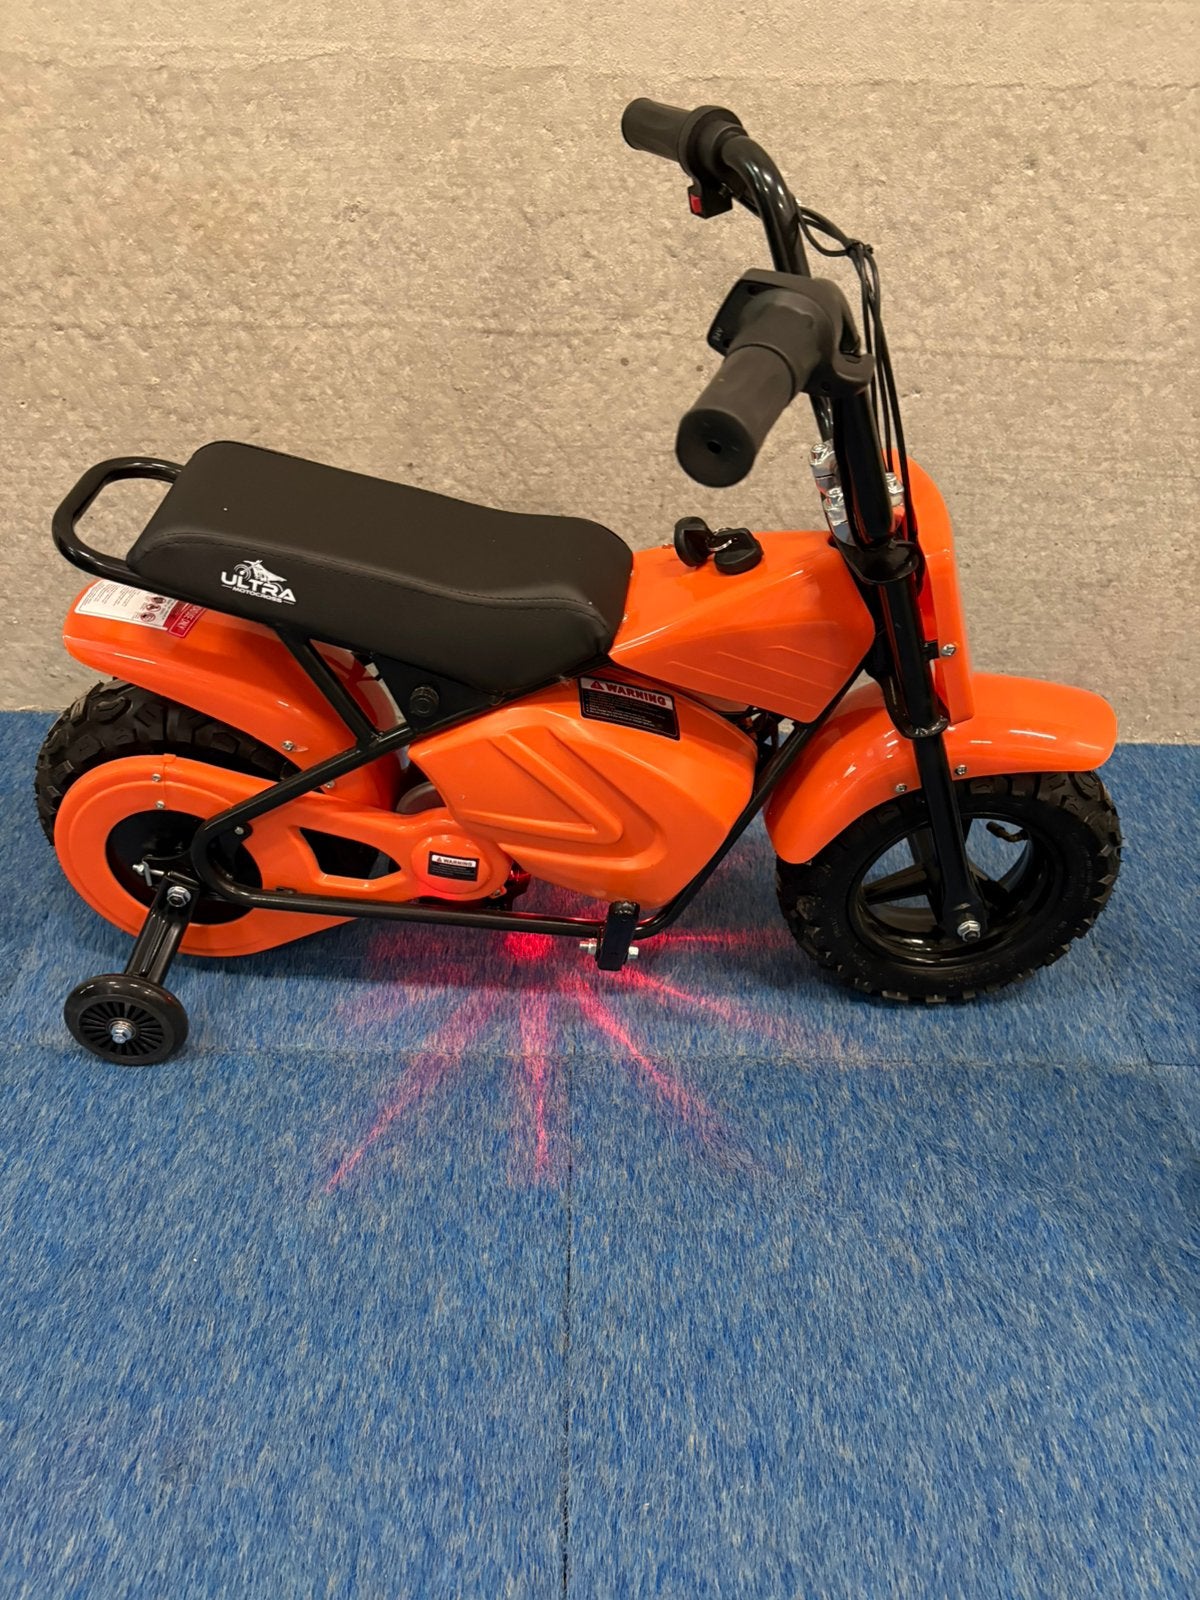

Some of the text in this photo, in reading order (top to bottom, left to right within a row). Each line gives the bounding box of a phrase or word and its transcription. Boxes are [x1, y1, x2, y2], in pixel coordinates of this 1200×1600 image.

[221, 571, 296, 602] ULTRA
[232, 586, 282, 603] MOTOCROSS
[604, 682, 667, 706] WARNING
